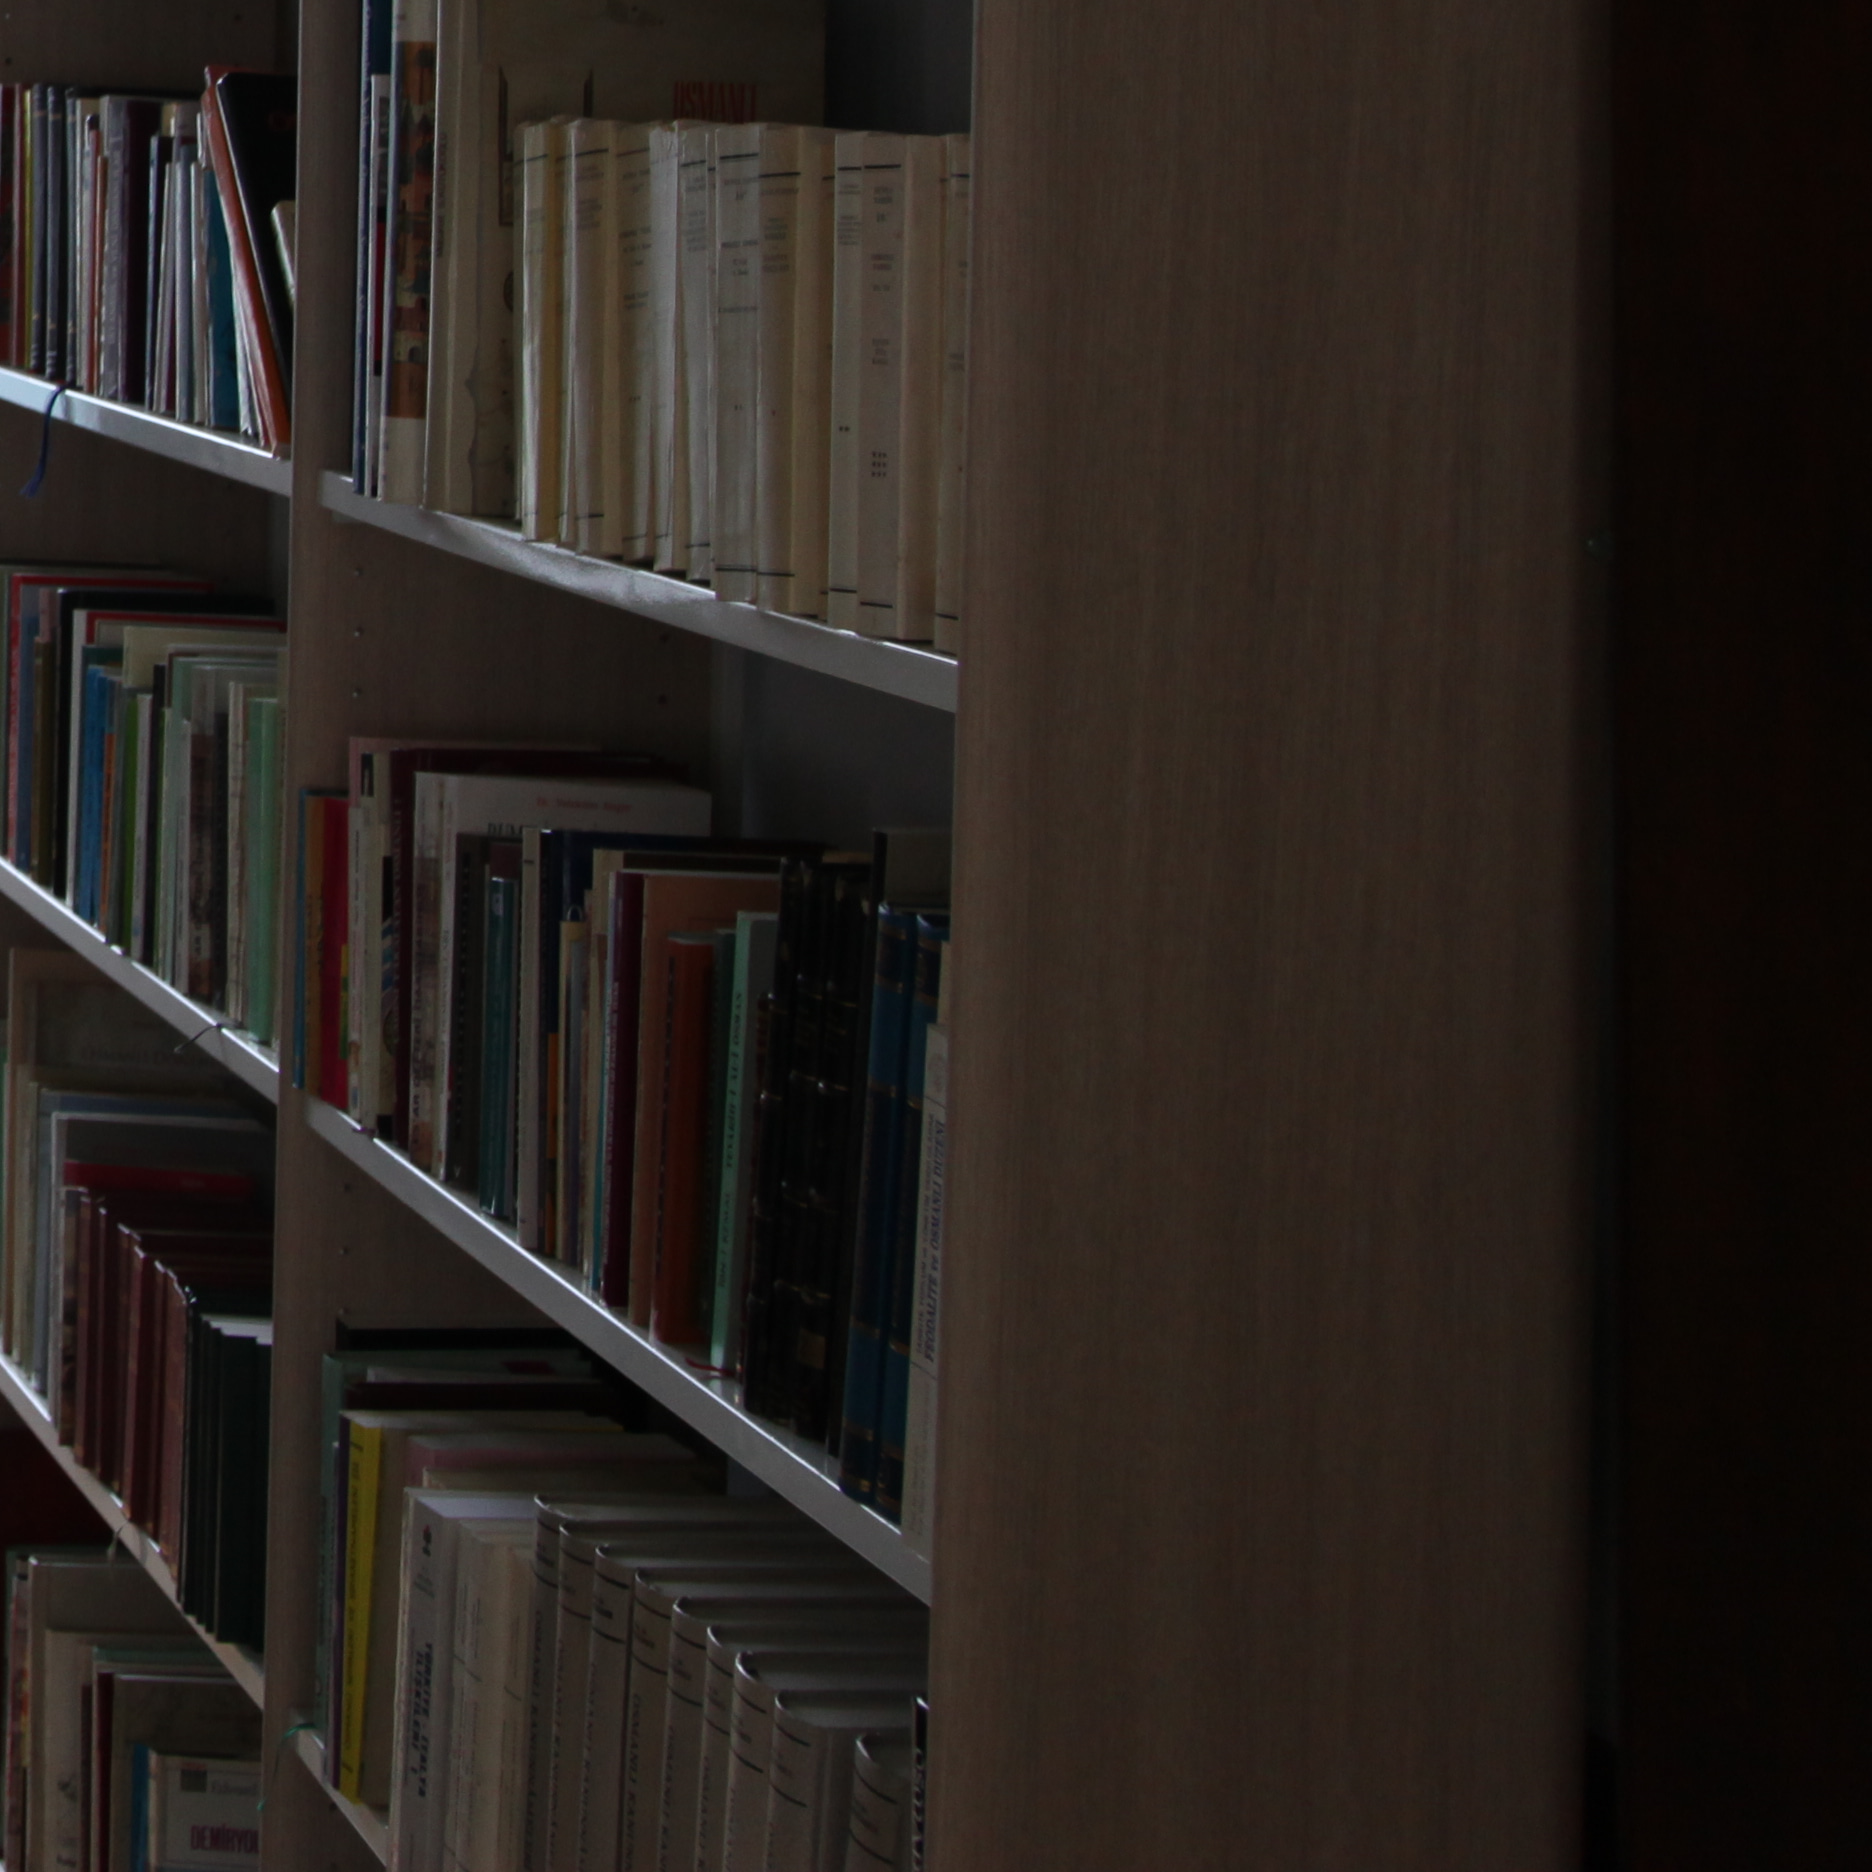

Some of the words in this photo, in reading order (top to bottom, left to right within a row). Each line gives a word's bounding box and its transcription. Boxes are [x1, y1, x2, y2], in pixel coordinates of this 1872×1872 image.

[731, 991, 744, 1046] OSMAN
[928, 1181, 944, 1251] OSMANLI
[422, 1642, 434, 1718] TÜRKİYE
[531, 1610, 545, 1697] OSMANLI
[417, 1735, 430, 1799] İTALYA
[628, 1693, 643, 1784] OSMANLI
